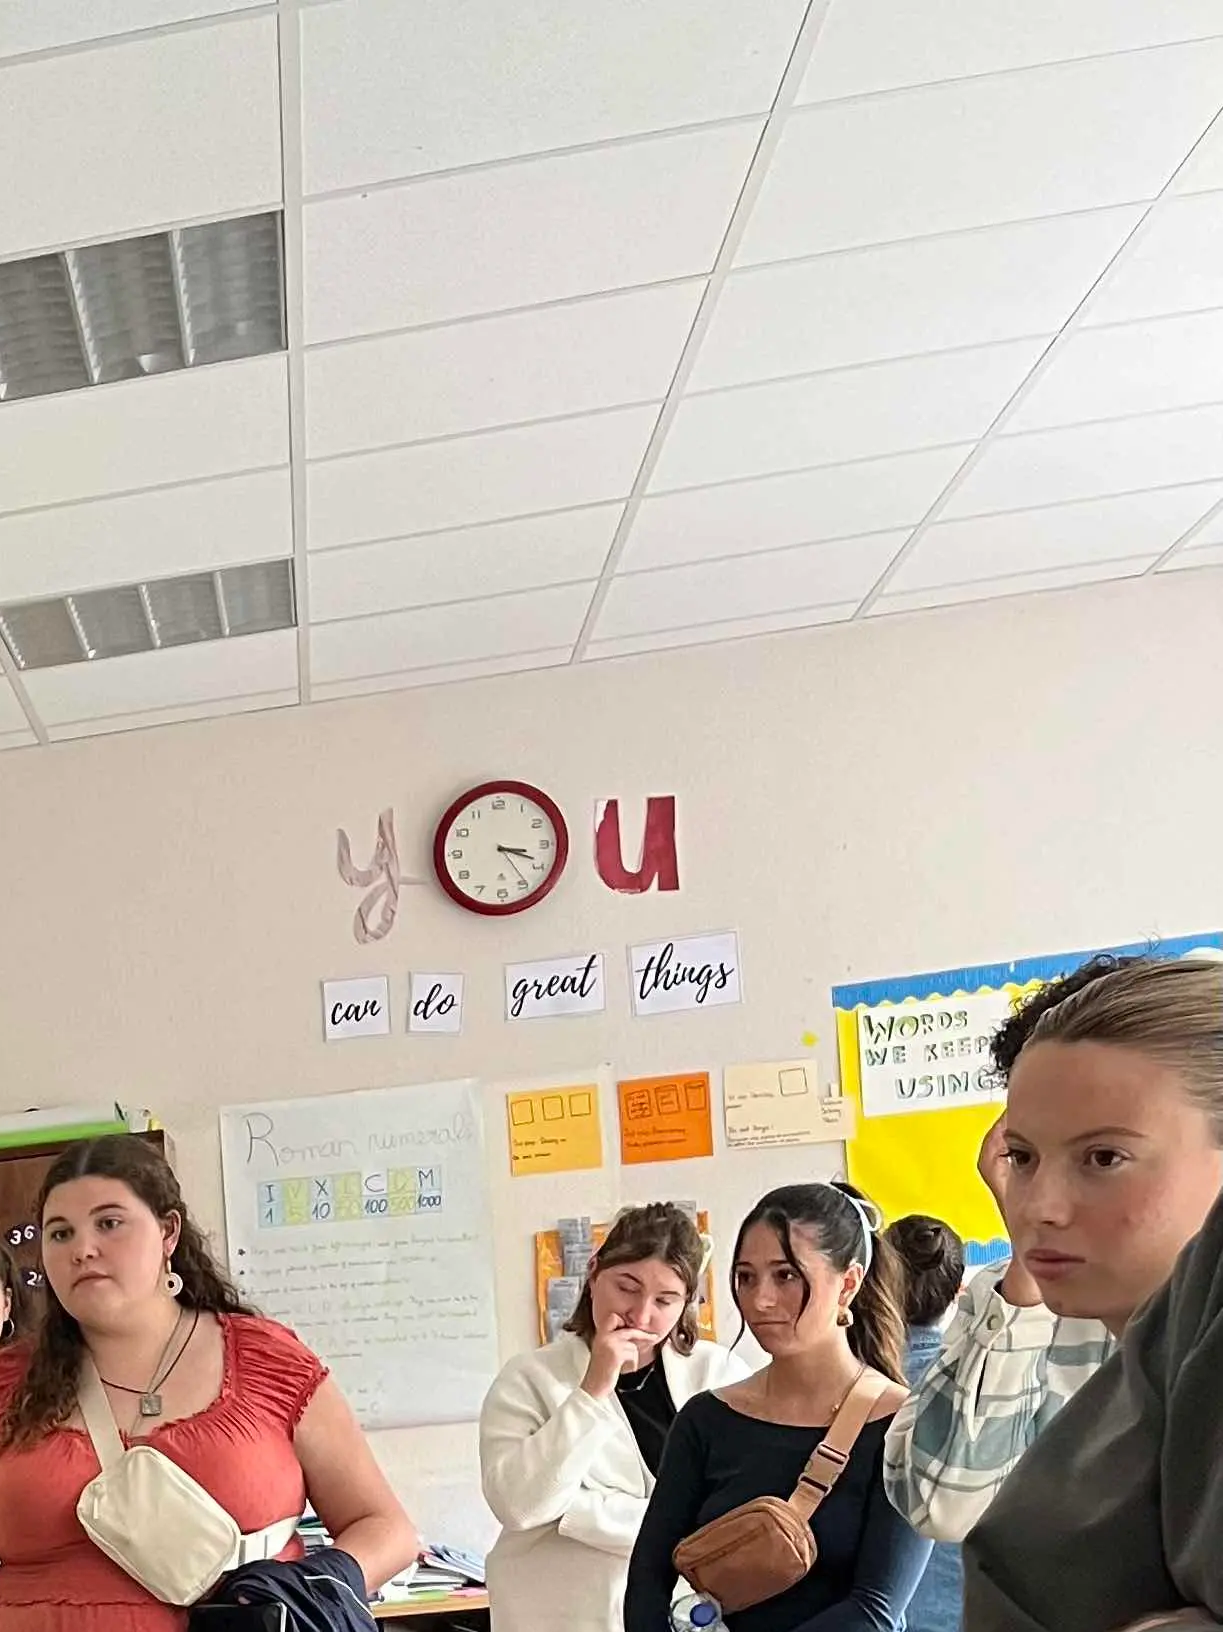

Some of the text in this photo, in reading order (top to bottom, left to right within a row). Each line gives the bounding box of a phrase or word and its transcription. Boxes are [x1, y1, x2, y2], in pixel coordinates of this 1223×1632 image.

[491, 799, 506, 810] 12
[472, 810, 481, 819] 11
[531, 818, 543, 829] 2
[456, 828, 469, 838] 10
[539, 839, 550, 850] 3
[592, 795, 680, 894] u
[451, 849, 463, 859] 9
[532, 863, 544, 872] 4
[458, 870, 470, 880] 8
[474, 884, 487, 895] 7
[517, 880, 529, 890] 5
[496, 888, 509, 899] 6
[331, 942, 735, 1026] can do great things
[862, 1009, 969, 1045] WORDS
[865, 1035, 989, 1067] WE KEEP
[894, 1066, 995, 1100] USING
[241, 1111, 355, 1168] Roman
[266, 1183, 275, 1204] I
[314, 1178, 329, 1198] X
[364, 1173, 385, 1194] C
[418, 1168, 435, 1188] M
[265, 1205, 274, 1224] 1
[312, 1202, 331, 1220] 10
[364, 1198, 389, 1215] 100
[417, 1193, 442, 1208] 1000
[9, 1225, 35, 1245] 3 6
